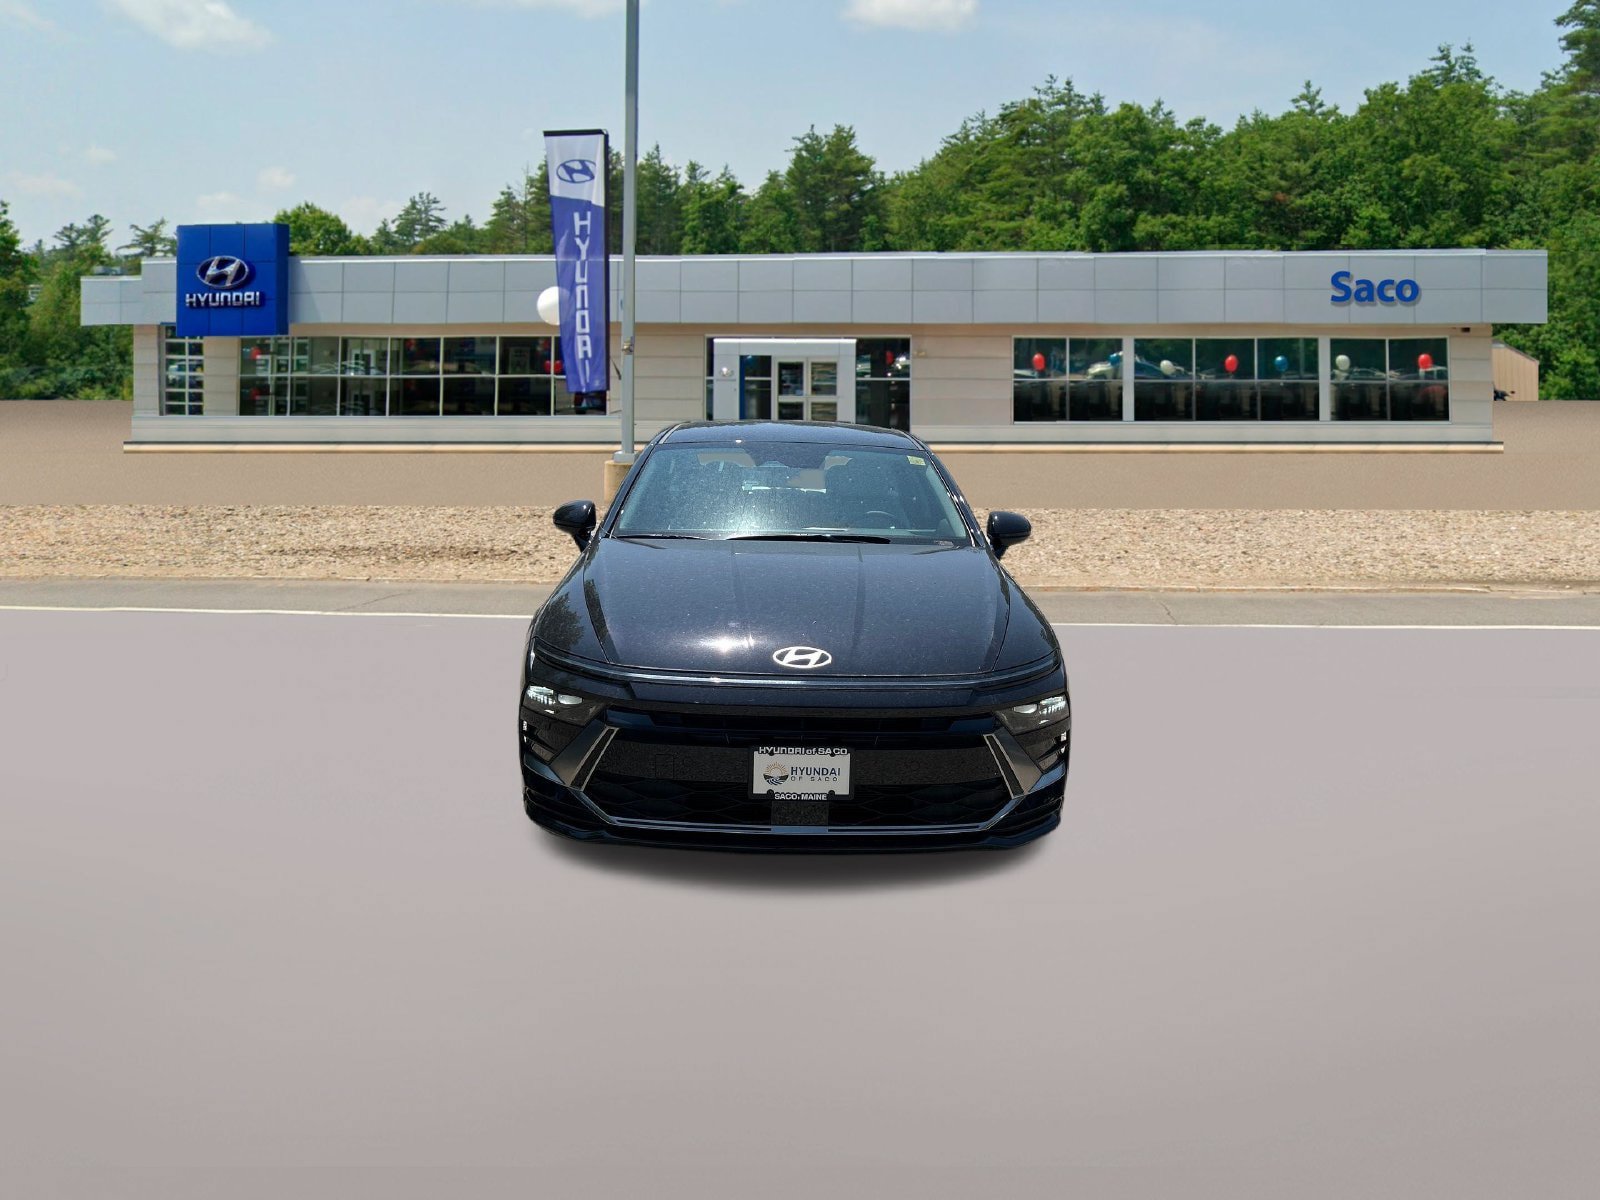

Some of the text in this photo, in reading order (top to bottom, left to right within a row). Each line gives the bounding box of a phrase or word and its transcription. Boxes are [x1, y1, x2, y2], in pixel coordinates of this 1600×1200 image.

[1330, 270, 1420, 303] Saco
[185, 291, 260, 307] HYUNDAI
[573, 211, 592, 384] HYUNDAI
[759, 746, 848, 755] HYUNDAI of SACO
[791, 767, 841, 776] HYUNDAI
